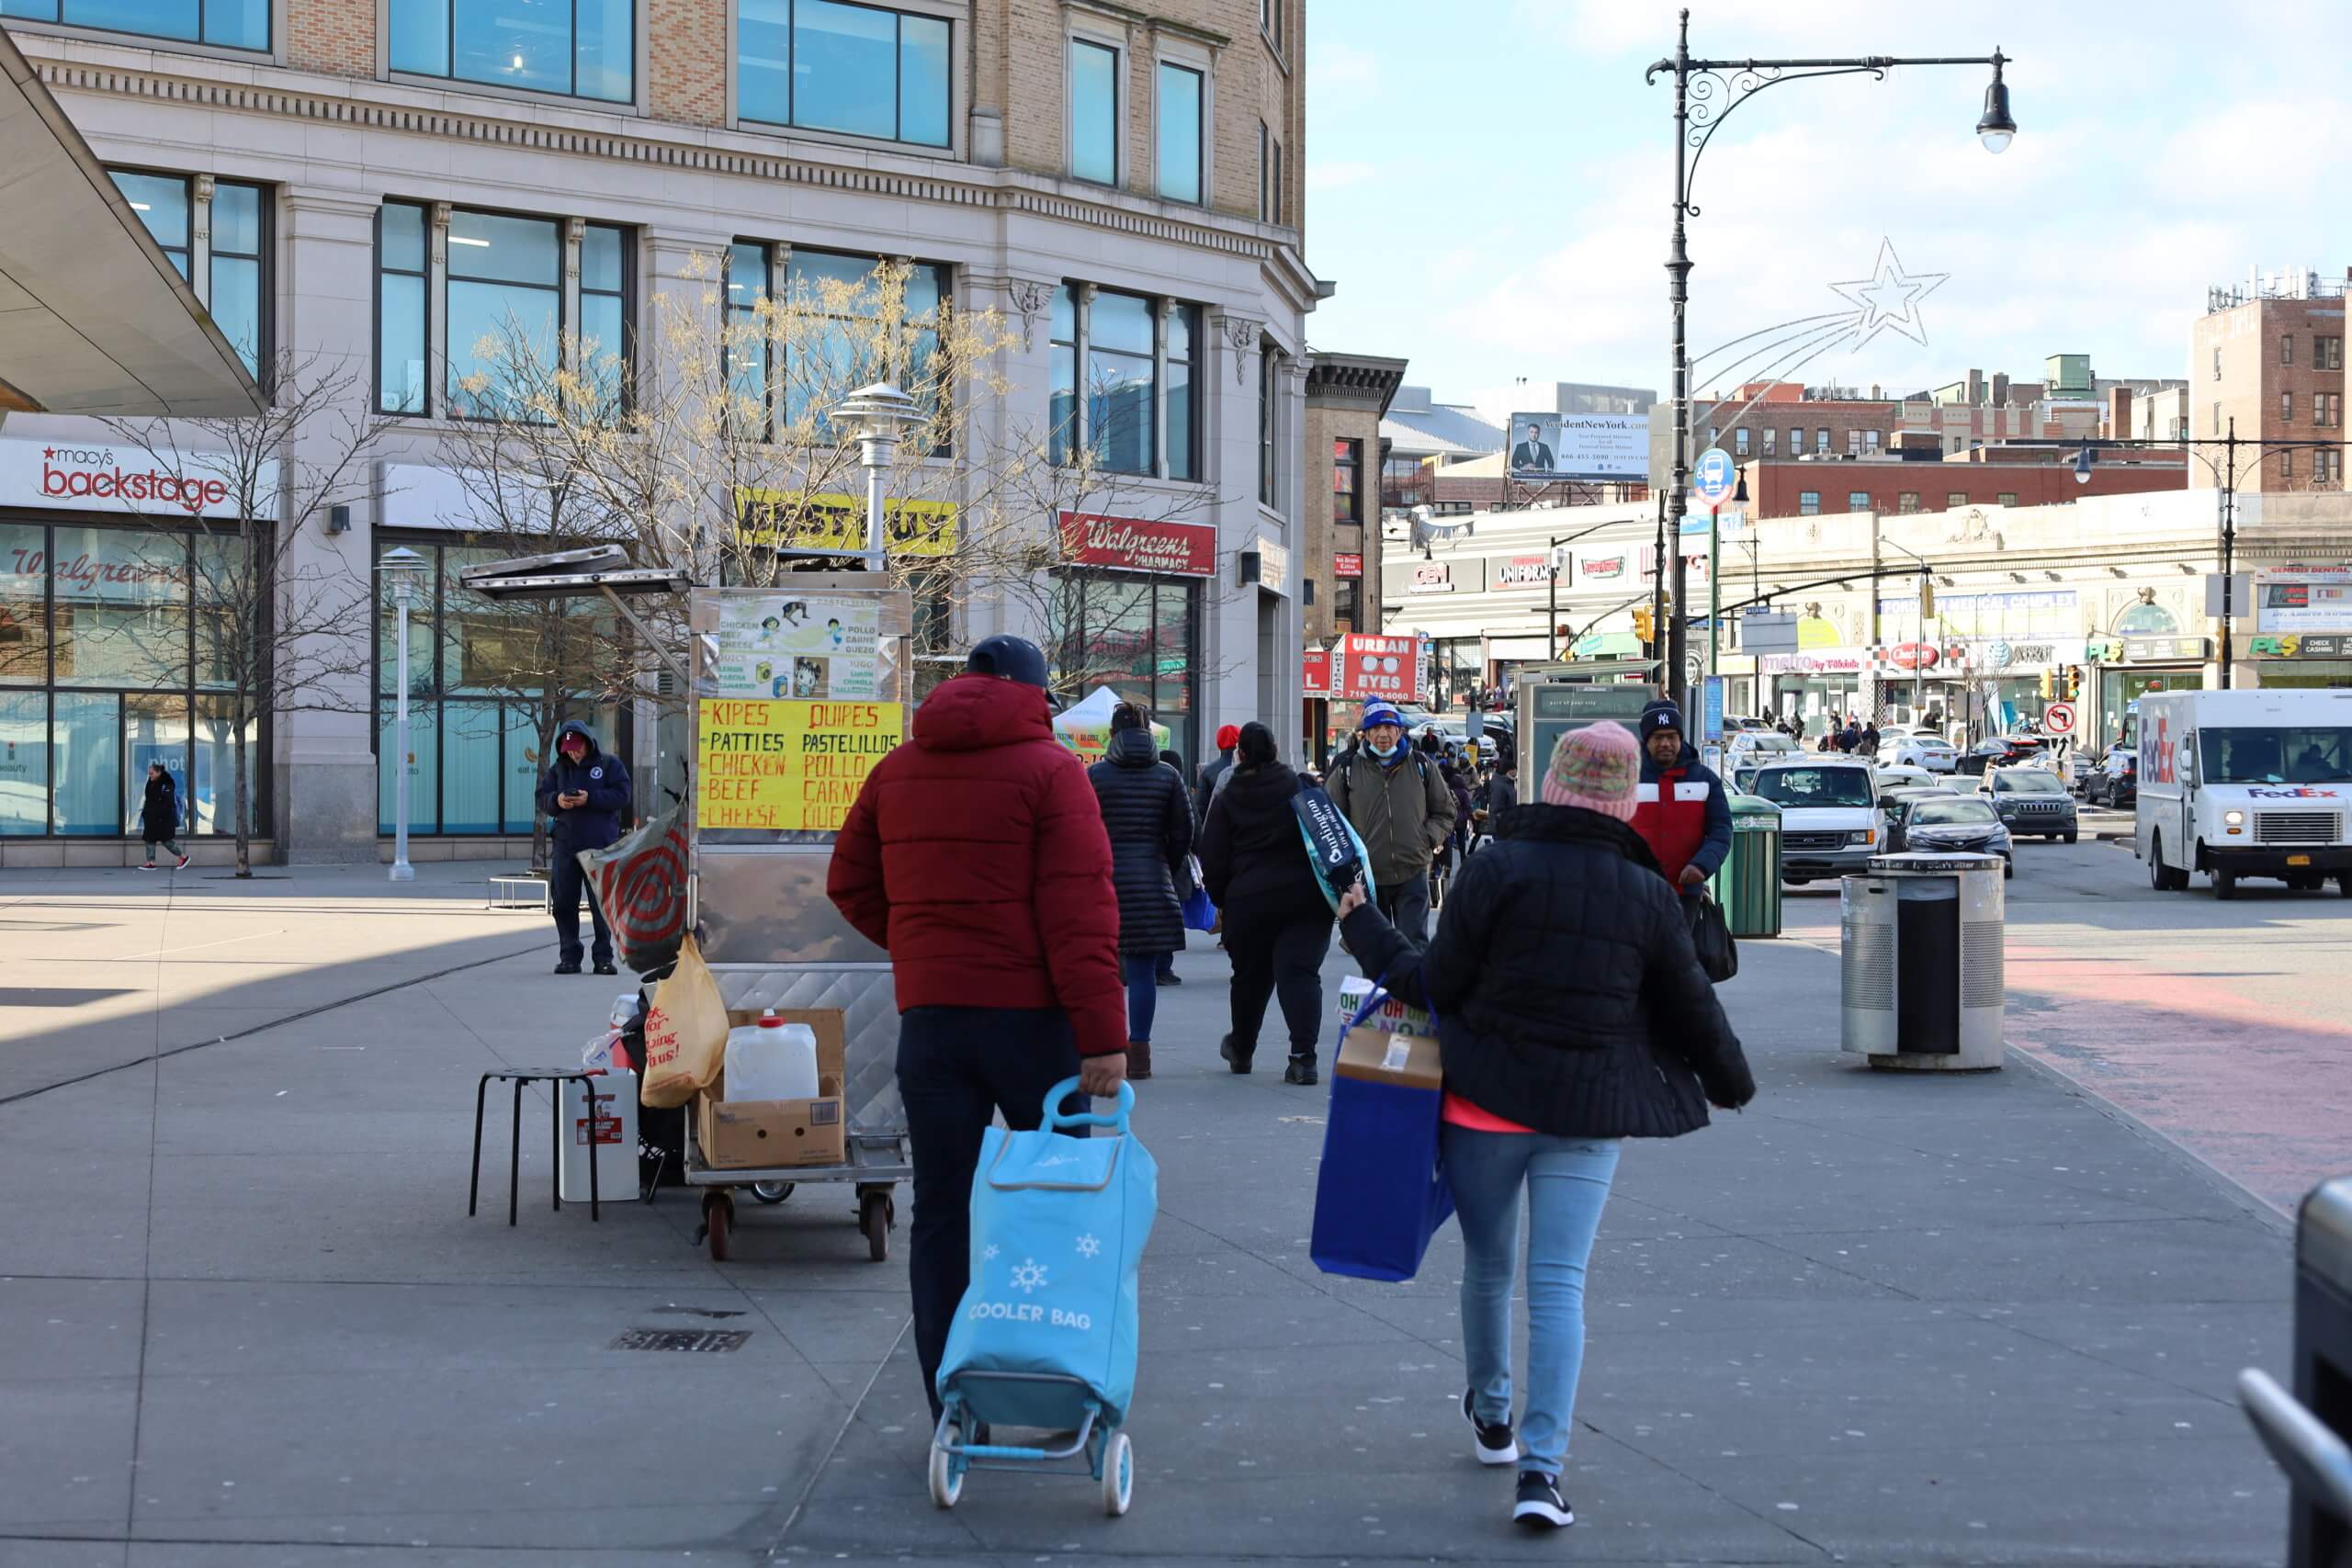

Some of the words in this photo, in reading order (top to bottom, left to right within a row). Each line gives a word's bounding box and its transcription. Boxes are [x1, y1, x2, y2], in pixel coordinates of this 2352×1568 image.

[58, 448, 113, 468] macy's
[44, 463, 225, 512] backstage
[744, 501, 850, 537] BEST
[1086, 520, 1191, 561] Walgreens
[1135, 556, 1188, 570] PHARMACY
[1413, 563, 1446, 583] GEM
[1884, 601, 1945, 615] FORDM
[1950, 595, 2006, 612] MEDICAL
[2011, 592, 2076, 608] COMPLEX
[720, 621, 758, 630] CHICKEN
[845, 636, 875, 644] CARNE
[1352, 638, 1409, 653] URBAN
[1764, 655, 1815, 671] metro
[2012, 645, 2054, 663] AT&T
[1358, 674, 1401, 689] EYES
[713, 704, 769, 726] KIPES
[710, 733, 784, 751] PATTIES
[802, 734, 899, 753] PASTELILLOS
[2142, 717, 2175, 784] FedEx
[709, 753, 786, 776] CHICKEN
[803, 755, 865, 778] POLLO
[708, 779, 763, 800] BEEF
[2247, 788, 2337, 798] FedEx
[707, 805, 779, 826] CHEESE
[1340, 993, 1359, 1010] OH
[1384, 999, 1404, 1019] OH
[646, 1018, 670, 1032] for
[659, 1043, 679, 1064] us!
[969, 1303, 1044, 1322] COOLER
[1051, 1308, 1091, 1330] BAG
